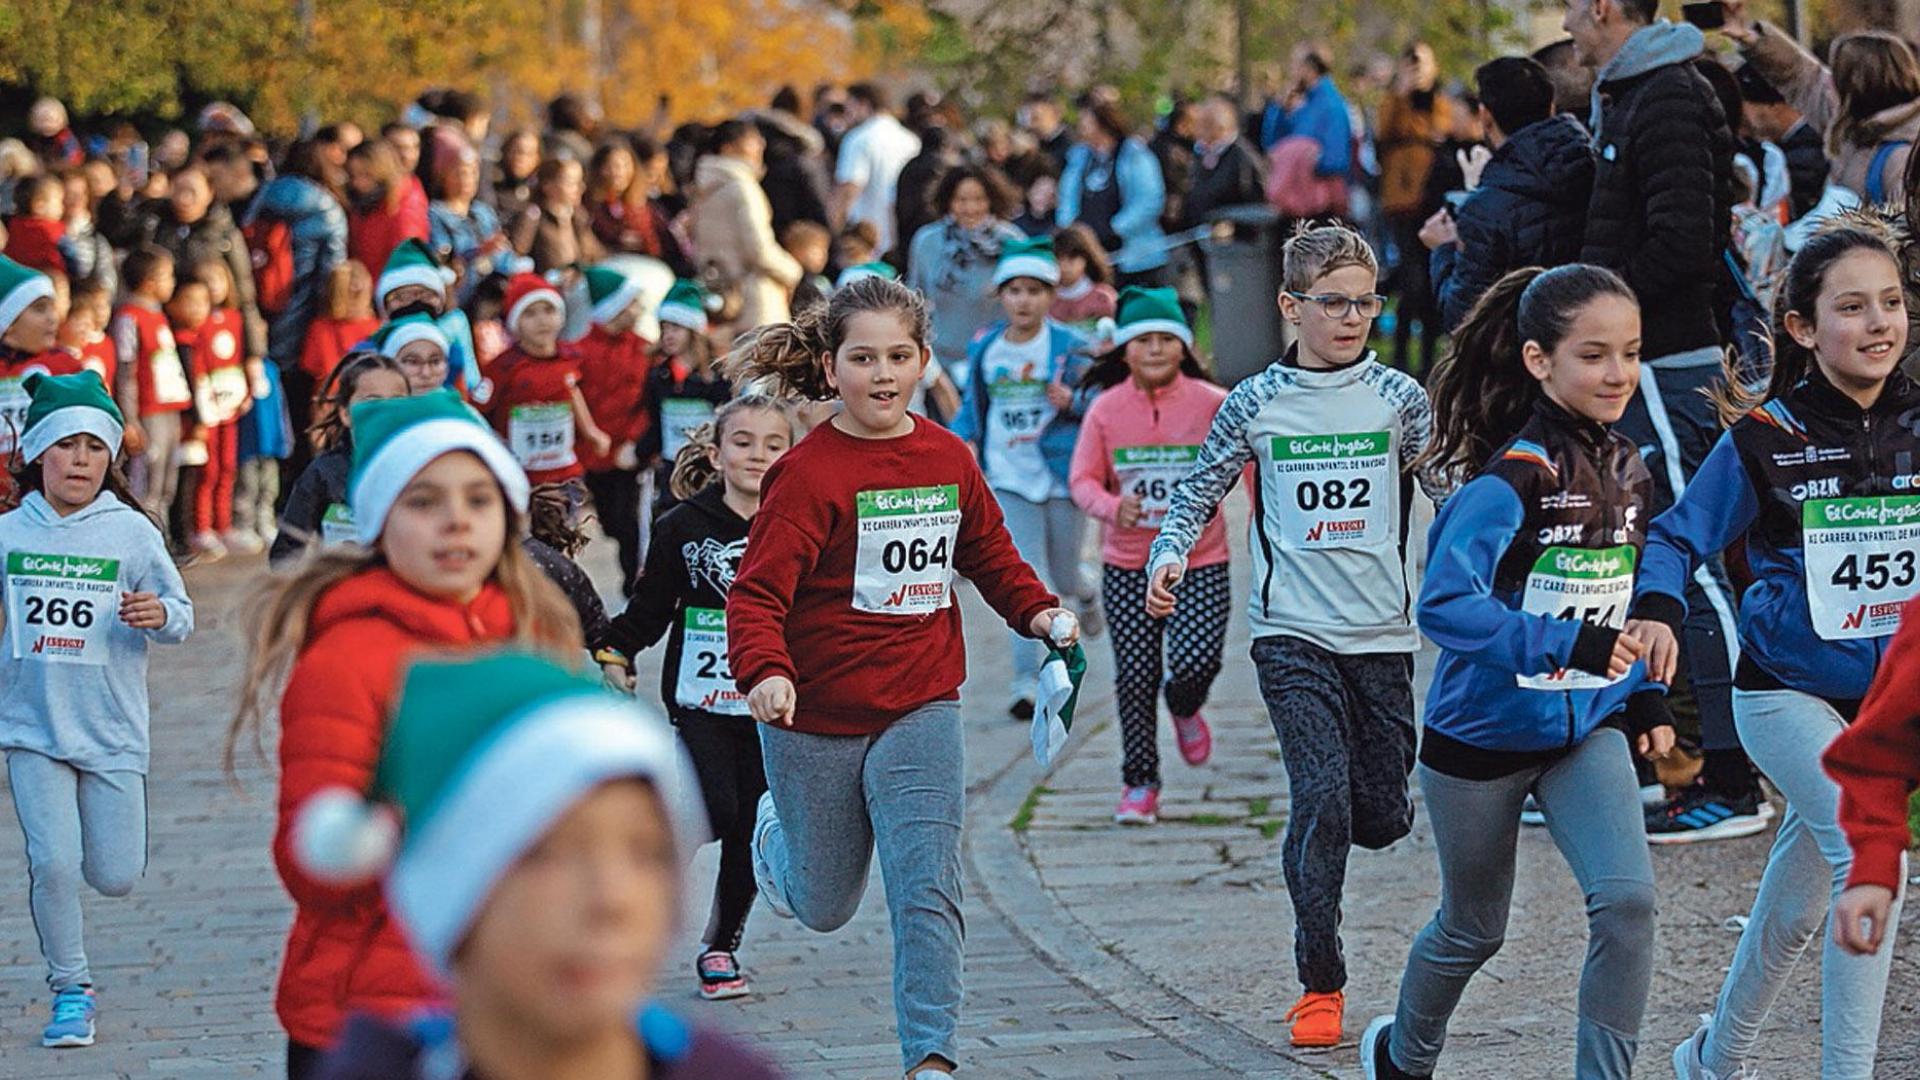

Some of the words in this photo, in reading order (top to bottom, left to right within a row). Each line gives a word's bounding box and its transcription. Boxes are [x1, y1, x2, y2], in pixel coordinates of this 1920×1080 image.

[1289, 439, 1302, 454] El
[1302, 440, 1332, 454] Corte
[1332, 435, 1375, 457] Inglés
[1285, 462, 1315, 472] CARRERA
[1317, 461, 1349, 471] INFANTIL
[1350, 460, 1359, 470] DE
[1296, 477, 1371, 511] 082
[1824, 503, 1841, 521] El
[1842, 503, 1878, 520] Corte
[1878, 498, 1920, 524] Inglé
[1819, 532, 1856, 544] CARRERA
[1858, 530, 1897, 542] INFANTIL
[1898, 528, 1908, 540] DE
[882, 535, 948, 574] 064
[1831, 549, 1916, 592] 453
[25, 595, 94, 629] 266
